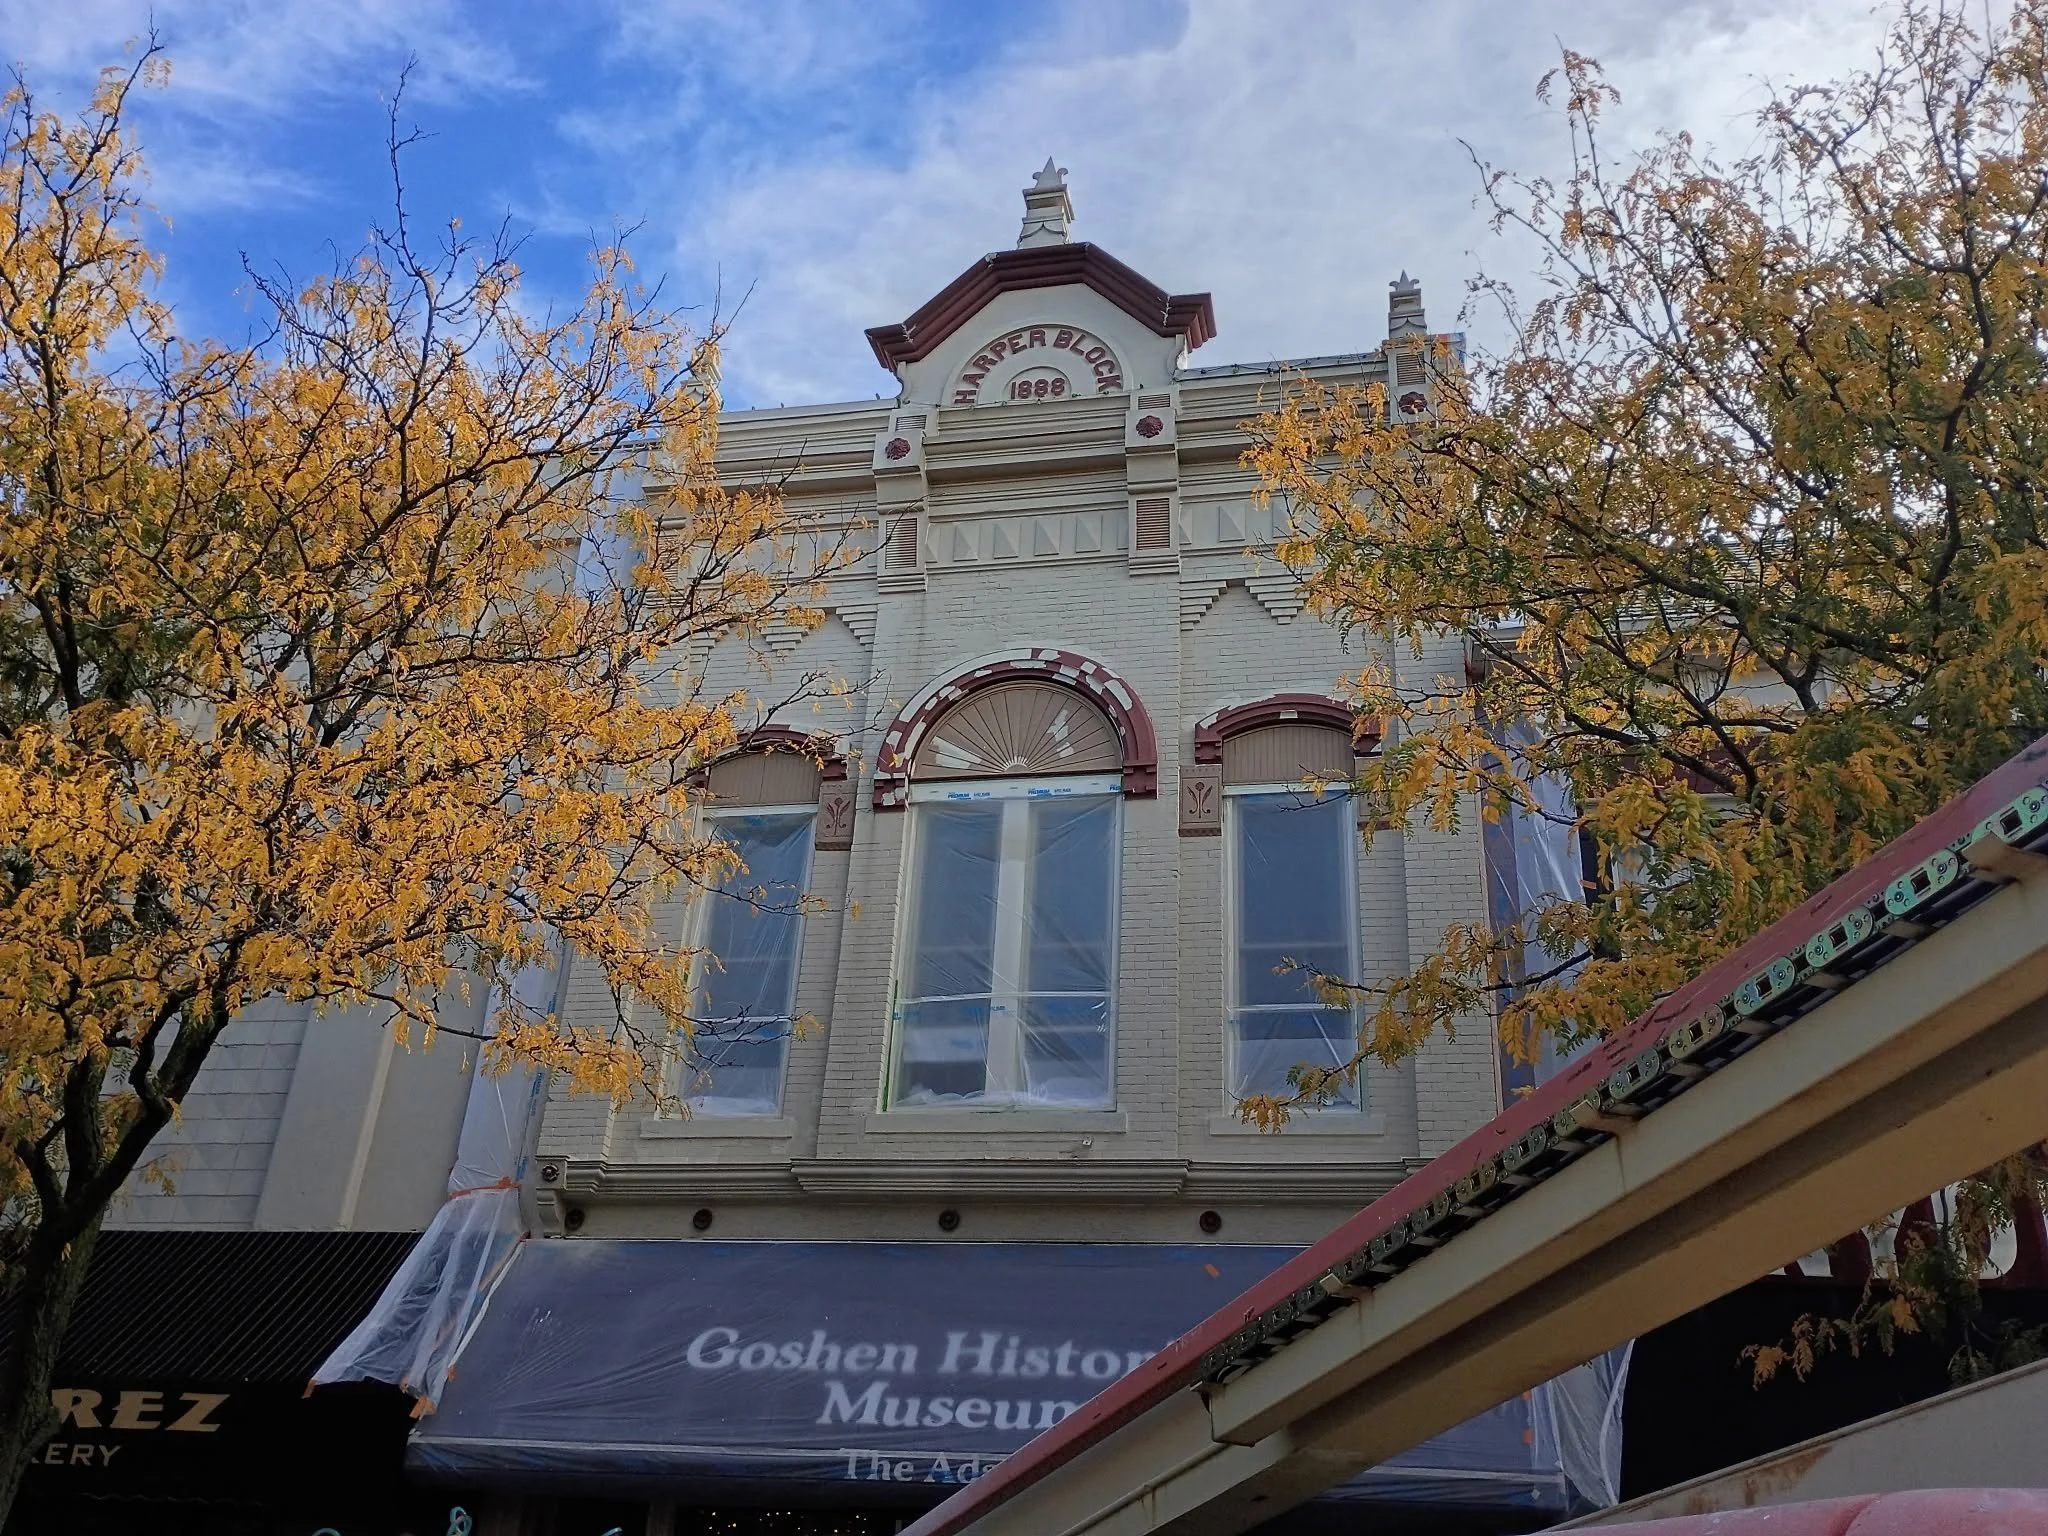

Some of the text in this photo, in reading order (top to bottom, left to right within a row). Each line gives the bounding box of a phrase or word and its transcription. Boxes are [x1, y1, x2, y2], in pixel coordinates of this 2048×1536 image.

[954, 328, 1123, 404] HARPER BLOCK
[1010, 377, 1065, 399] 1888
[687, 1327, 1158, 1379] Goshen Histor
[31, 1443, 121, 1467] ERY
[841, 1448, 914, 1482] The
